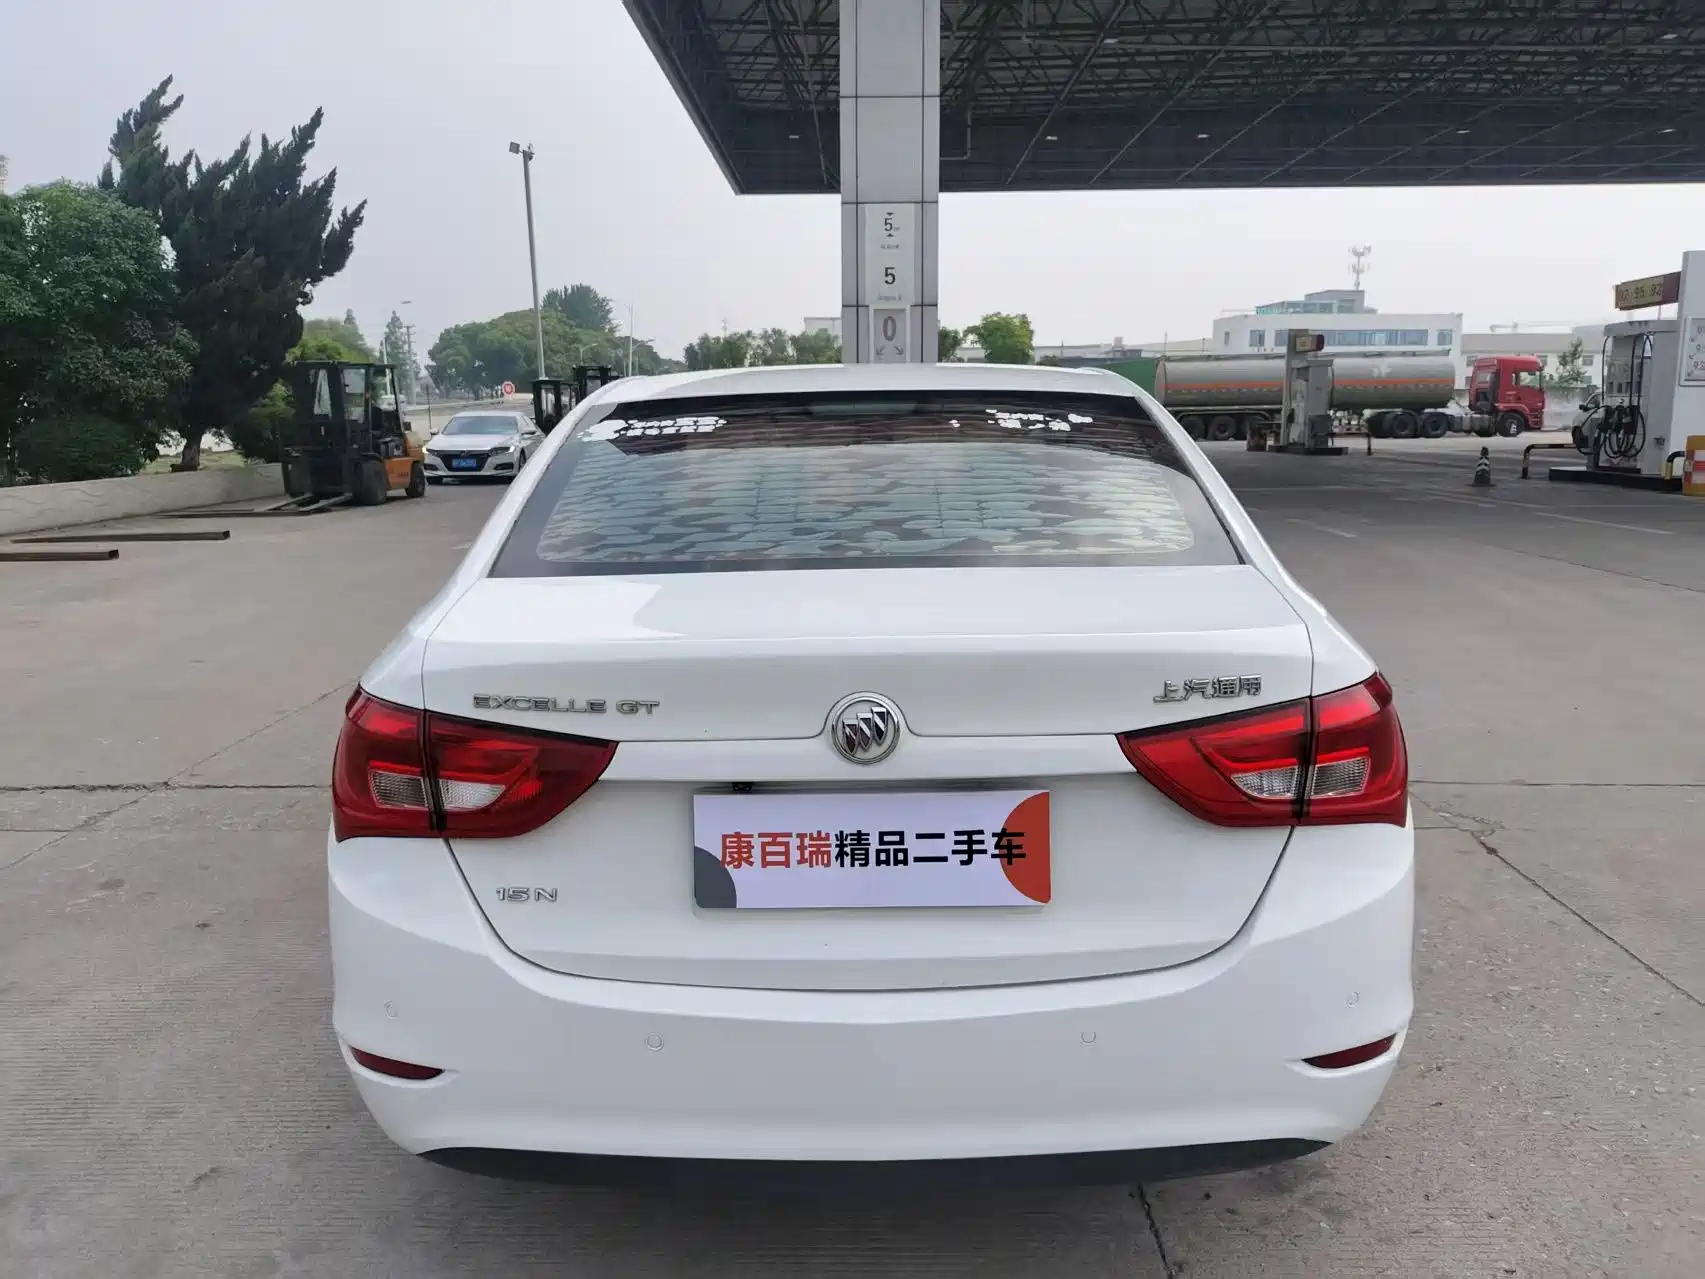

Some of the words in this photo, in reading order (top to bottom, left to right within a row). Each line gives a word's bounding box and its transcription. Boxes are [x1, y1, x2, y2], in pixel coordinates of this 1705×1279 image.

[884, 267, 896, 285] 5
[882, 316, 897, 341] 0
[1153, 674, 1262, 703] 上汽通用
[473, 694, 607, 713] EXCELLE
[615, 699, 661, 714] GT
[720, 827, 1027, 869] 康百瑞精品二手车
